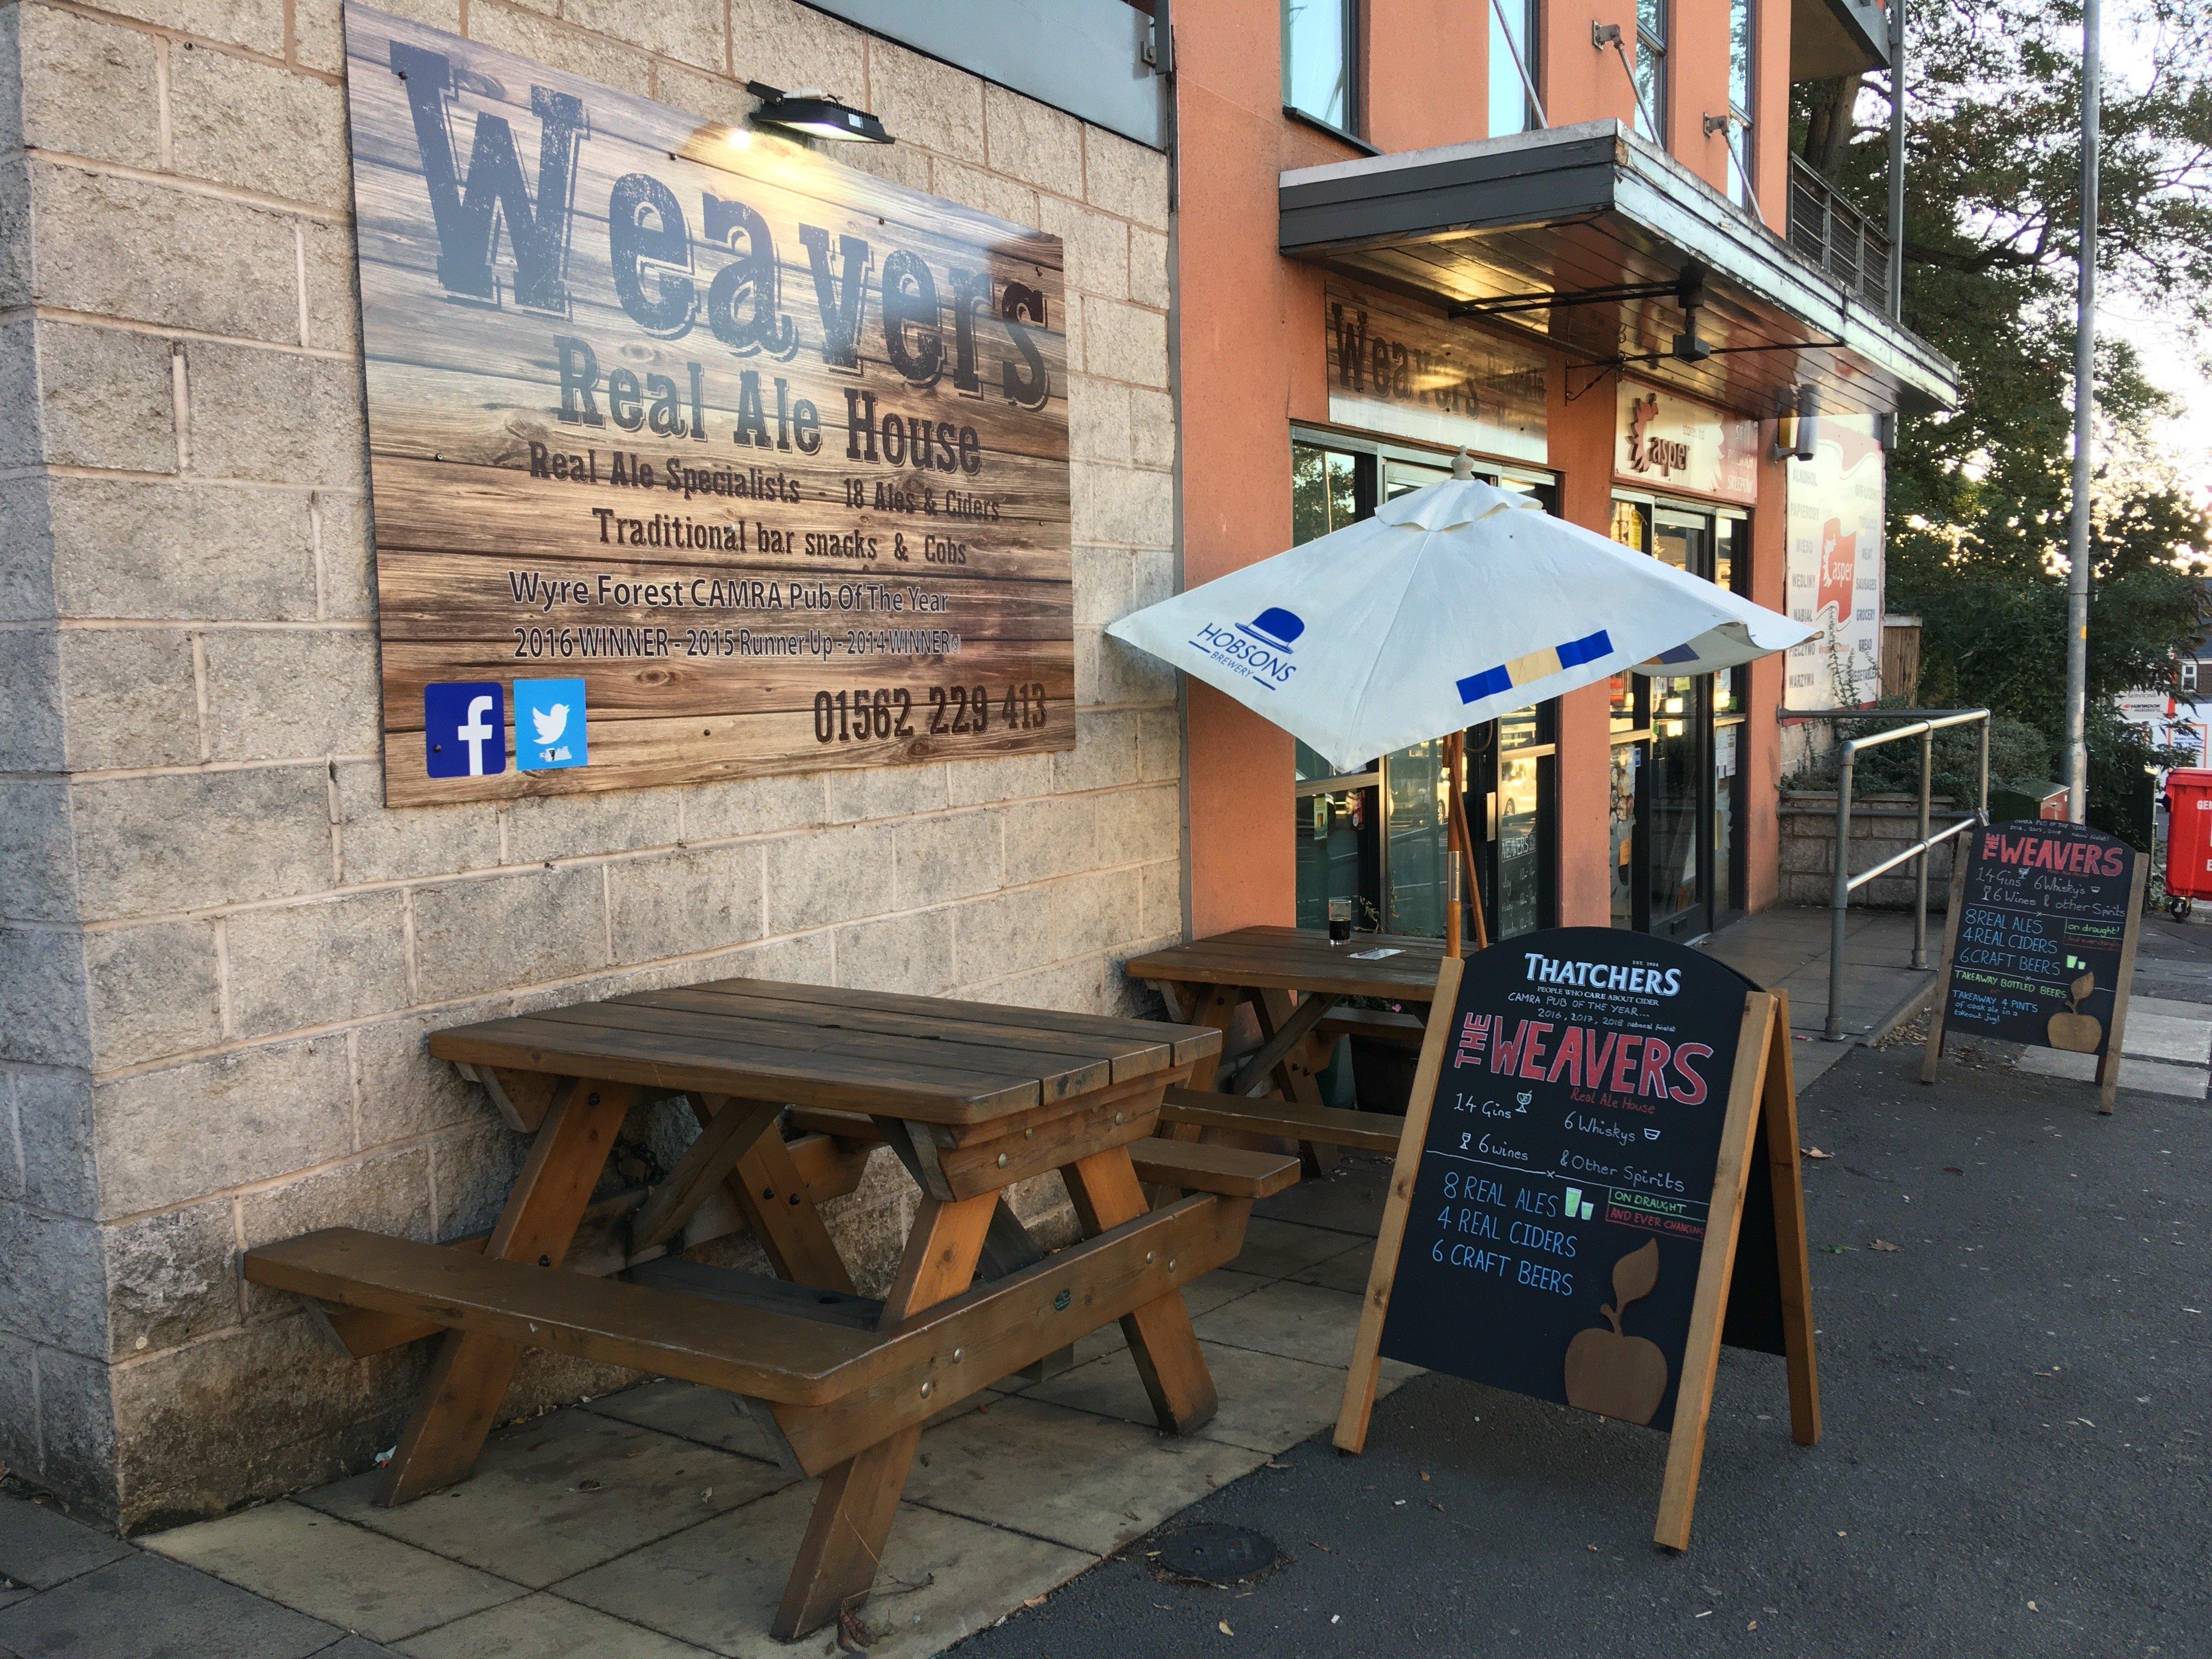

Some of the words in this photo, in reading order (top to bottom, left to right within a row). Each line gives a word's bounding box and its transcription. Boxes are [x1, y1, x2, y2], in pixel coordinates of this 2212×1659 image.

[389, 39, 1049, 411] Weavers
[554, 334, 708, 442] Real
[733, 370, 822, 455] Ale
[844, 387, 982, 476] House
[528, 441, 597, 484] Real
[610, 451, 654, 489] Ale
[666, 458, 801, 504] Specialists
[844, 478, 865, 510] 18
[873, 481, 916, 515] Ales
[924, 487, 938, 517] &
[946, 489, 1000, 522] Ciders
[1792, 467, 1818, 487] ALKOHOL
[1790, 502, 1820, 521] PAPIEROSY
[591, 507, 747, 552] Traditional
[756, 521, 795, 554] bar
[805, 529, 878, 561] snacks
[894, 532, 909, 562] &
[925, 534, 967, 565] Cobs
[508, 570, 589, 613] Wyre
[597, 574, 685, 607] Forest
[690, 577, 784, 610] CAMRA
[789, 582, 832, 611] Pub
[838, 583, 863, 612] Of
[866, 584, 904, 613] The
[907, 586, 950, 613] Year
[1857, 608, 1876, 622] GROCERY
[513, 627, 574, 659] 2016
[577, 626, 670, 658] WINNER
[686, 628, 735, 657] 2015
[740, 628, 806, 657] Runner
[808, 628, 833, 663] Up
[847, 629, 886, 656] 2014
[1197, 623, 1297, 682] HOBSONS
[1859, 638, 1872, 652] BREAD
[1210, 651, 1254, 679] BREWERY
[814, 687, 915, 744] 01562
[929, 685, 988, 736] 229
[1002, 682, 1047, 730] 413
[1983, 832, 2001, 860] THE
[2000, 834, 2124, 877] WEAVERS
[1976, 866, 1995, 883] 14
[1996, 870, 2022, 887] Gins
[2034, 874, 2044, 890] 6
[1993, 887, 2003, 901] 6
[2005, 890, 2037, 906] Wines
[2055, 899, 2090, 911] other
[2092, 902, 2126, 917] Spirits
[1965, 909, 1976, 924] 8
[1977, 910, 2007, 929] REAL
[2012, 916, 2044, 934] ALES
[1962, 927, 1974, 942] 4
[1974, 927, 2005, 947] REAL
[2008, 934, 2058, 955] CIDERS
[1524, 952, 1682, 997] THATCHERS
[1960, 947, 1971, 963] 6
[1971, 949, 2017, 968] CRAFT
[2019, 956, 2061, 976] BEERS
[1537, 985, 1564, 996] PEOPLE
[1565, 989, 1584, 998] WHO
[1584, 990, 1606, 1001] CARE
[1607, 994, 1634, 1003] ABOUT
[1635, 997, 1660, 1007] CIDER
[1954, 969, 1999, 986] TAKEAWAY
[2000, 978, 2036, 993] BOTTLED
[2040, 985, 2067, 998] BEERS
[1508, 991, 1541, 1005] CAMRA
[1546, 995, 1568, 1007] PUB
[1572, 999, 1584, 1009] OF
[1587, 1001, 1609, 1012] THE
[1952, 989, 1997, 1005] TAKEAWAY
[2011, 1000, 2039, 1013] PINTS
[1954, 1009, 1982, 1019] takeout
[1955, 1001, 1965, 1009] of
[1967, 1003, 1985, 1011] cask
[2002, 1007, 2011, 1015] in
[1602, 1017, 1624, 1028] 2018
[1454, 1012, 1492, 1069] THE
[1490, 1015, 1715, 1106] WEAVERS
[1453, 1092, 1477, 1113] 14
[1481, 1100, 1512, 1120] Gins
[1570, 1087, 1596, 1104] Real
[1599, 1092, 1618, 1108] Ale
[1621, 1097, 1656, 1115] House
[1564, 1110, 1577, 1130] 6
[1578, 1114, 1636, 1147] Whiskys
[1478, 1133, 1492, 1153] 6
[1491, 1141, 1529, 1161] wines
[1560, 1149, 1570, 1167] &
[1571, 1154, 1619, 1176] Other
[1623, 1165, 1685, 1193] Spirits
[1443, 1171, 1459, 1199] 8
[1463, 1176, 1507, 1207] REAL
[1514, 1187, 1559, 1218] ALES
[1614, 1191, 1632, 1203] ON
[1634, 1194, 1688, 1214] DRAUGHT
[1611, 1206, 1633, 1222] AND
[1633, 1212, 1662, 1227] EVER
[1437, 1205, 1452, 1230] 4
[1458, 1207, 1500, 1240] REAL
[1509, 1221, 1578, 1258] CIDERS
[1432, 1239, 1444, 1262] 6
[1450, 1243, 1511, 1277] CRAFT
[1517, 1260, 1574, 1296] BEERS
